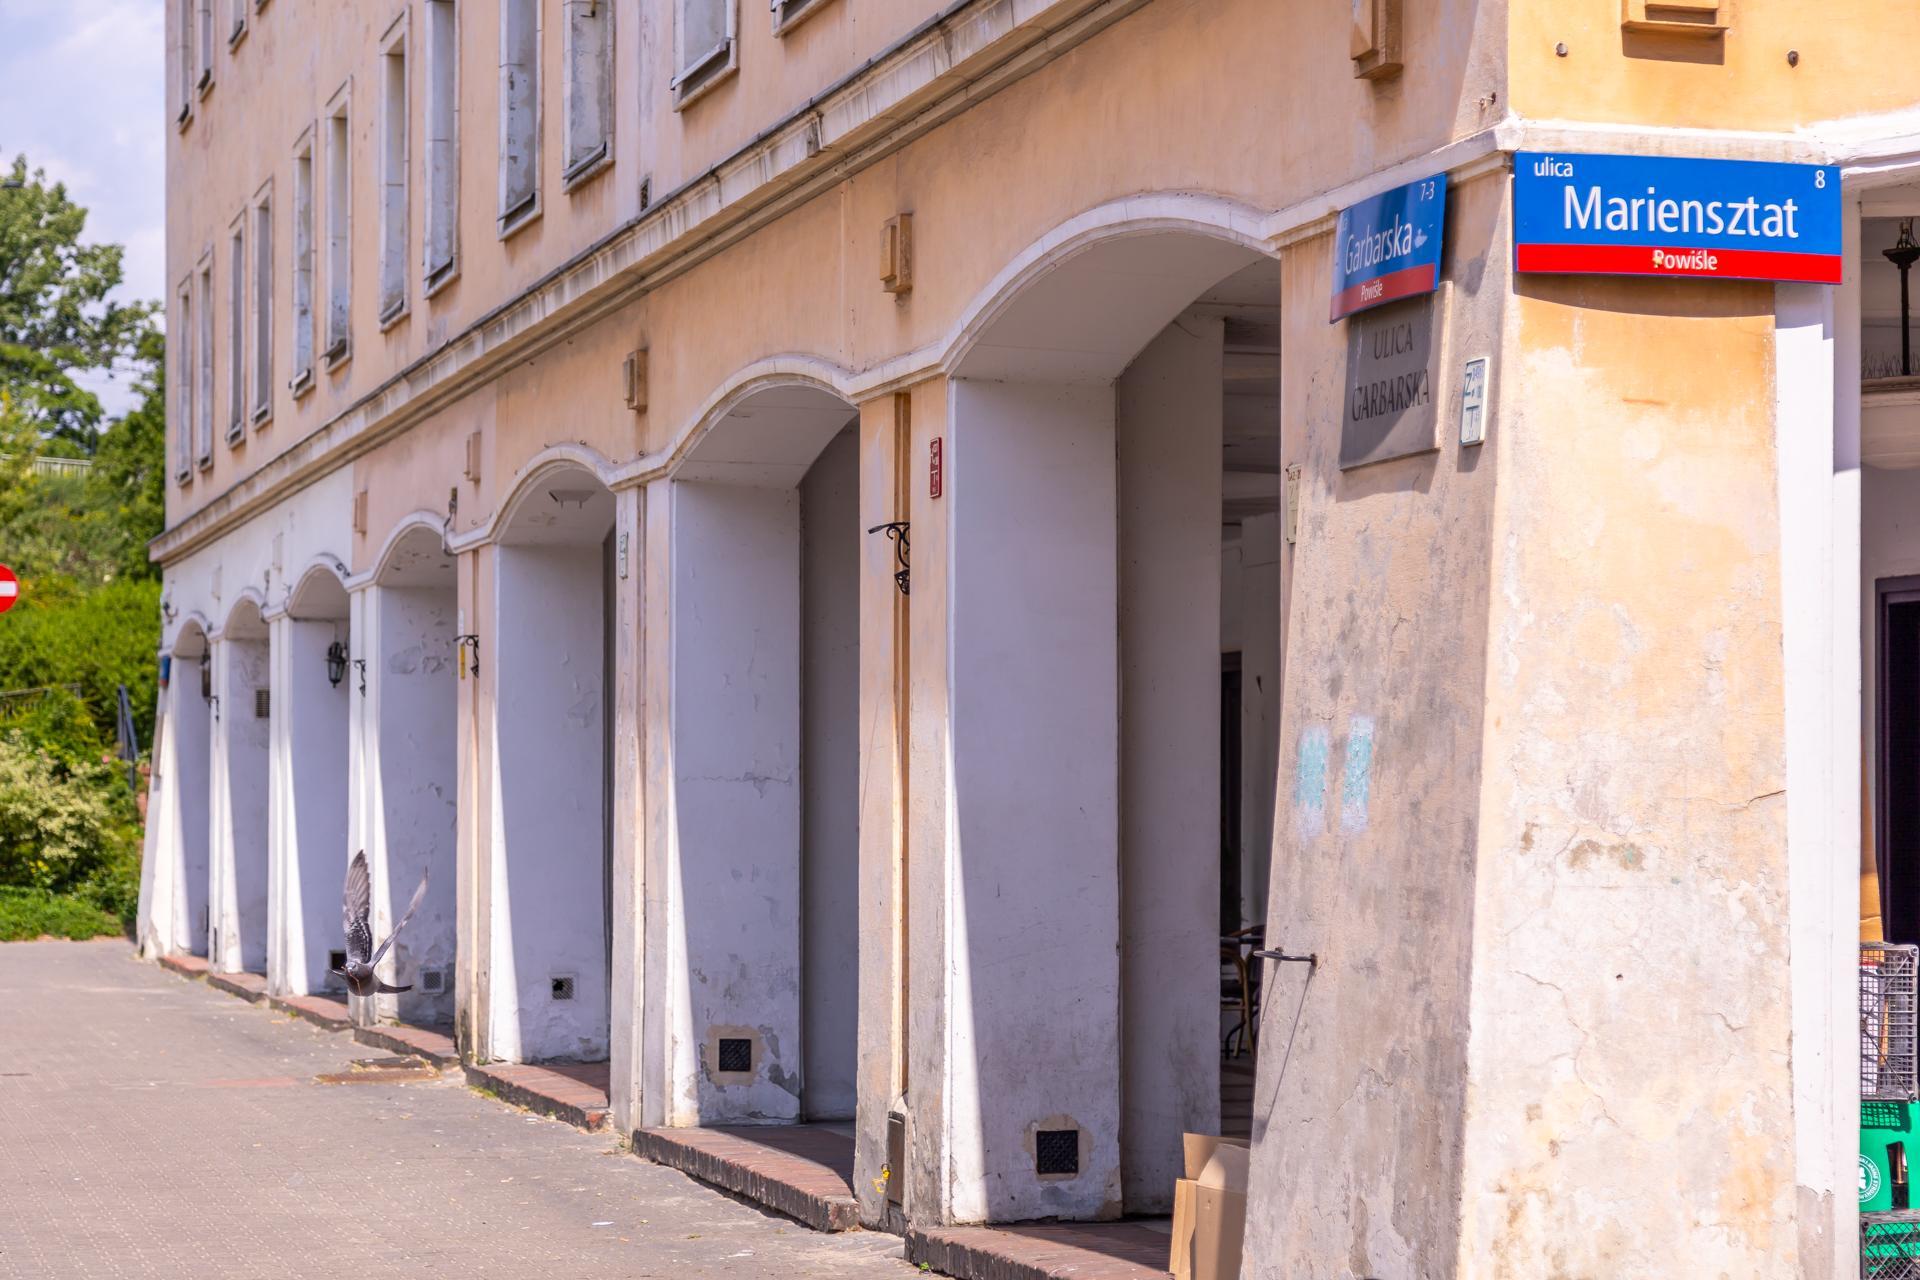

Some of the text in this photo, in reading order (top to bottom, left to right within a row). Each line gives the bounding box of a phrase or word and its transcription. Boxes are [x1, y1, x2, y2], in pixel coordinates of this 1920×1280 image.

[1534, 157, 1573, 177] ulica
[1814, 169, 1826, 189] 8
[1421, 181, 1435, 201] 7-3
[1564, 185, 1799, 238] Mariensztat
[1345, 213, 1413, 275] Garbarska
[1653, 250, 1718, 270] Powiśle
[1361, 279, 1383, 301] Powiśle
[1374, 323, 1413, 360] ULICA
[1352, 369, 1430, 421] GARBARSKA
